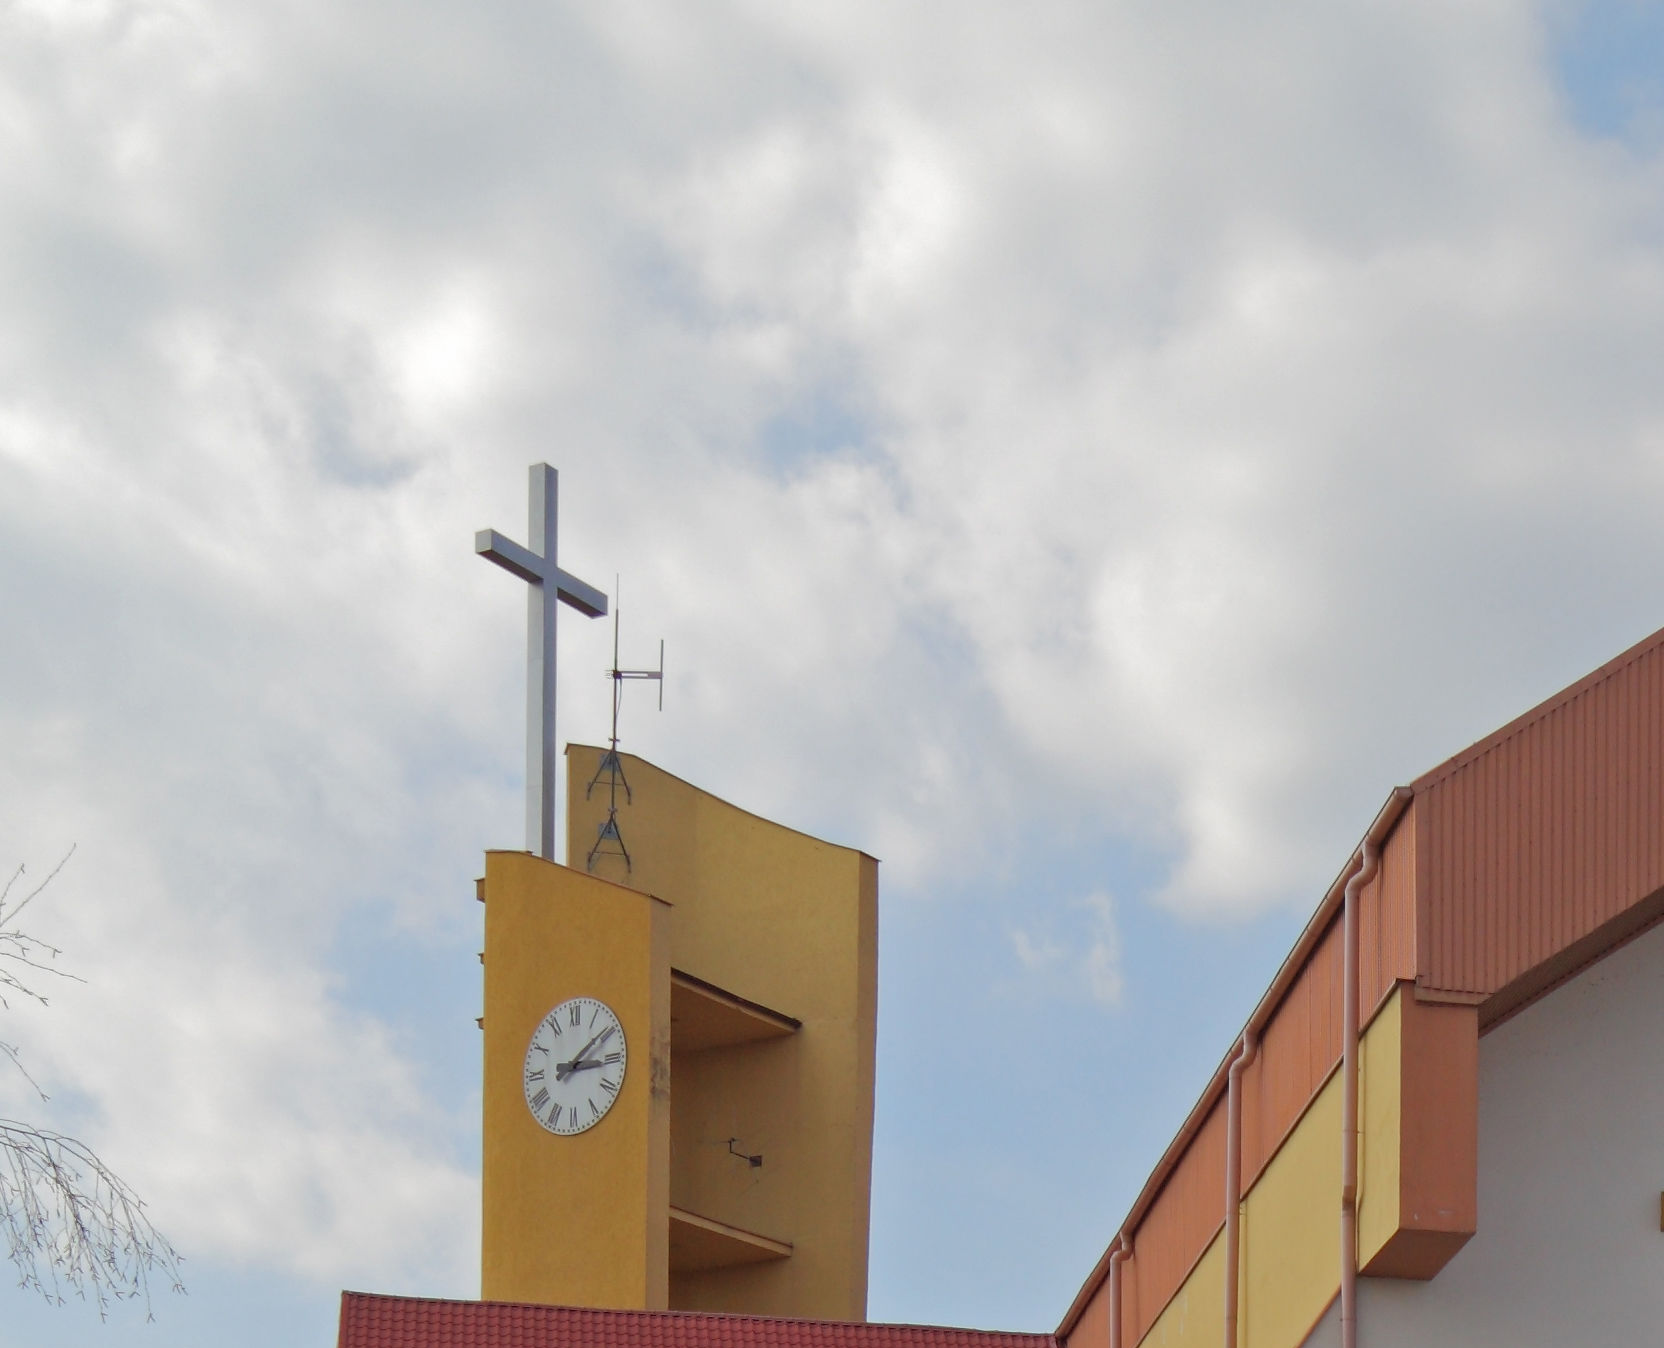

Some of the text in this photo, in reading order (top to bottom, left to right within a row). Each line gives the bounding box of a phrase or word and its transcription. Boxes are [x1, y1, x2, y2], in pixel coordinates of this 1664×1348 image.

[570, 1005, 581, 1027] XII
[546, 1017, 562, 1038] XI
[534, 1043, 549, 1056] X
[604, 1052, 621, 1065] III
[529, 1069, 544, 1081] IX
[600, 1078, 618, 1097] IV
[532, 1087, 551, 1111] VIII
[588, 1098, 600, 1119] V
[548, 1103, 562, 1127] VII
[569, 1106, 578, 1128] VI
